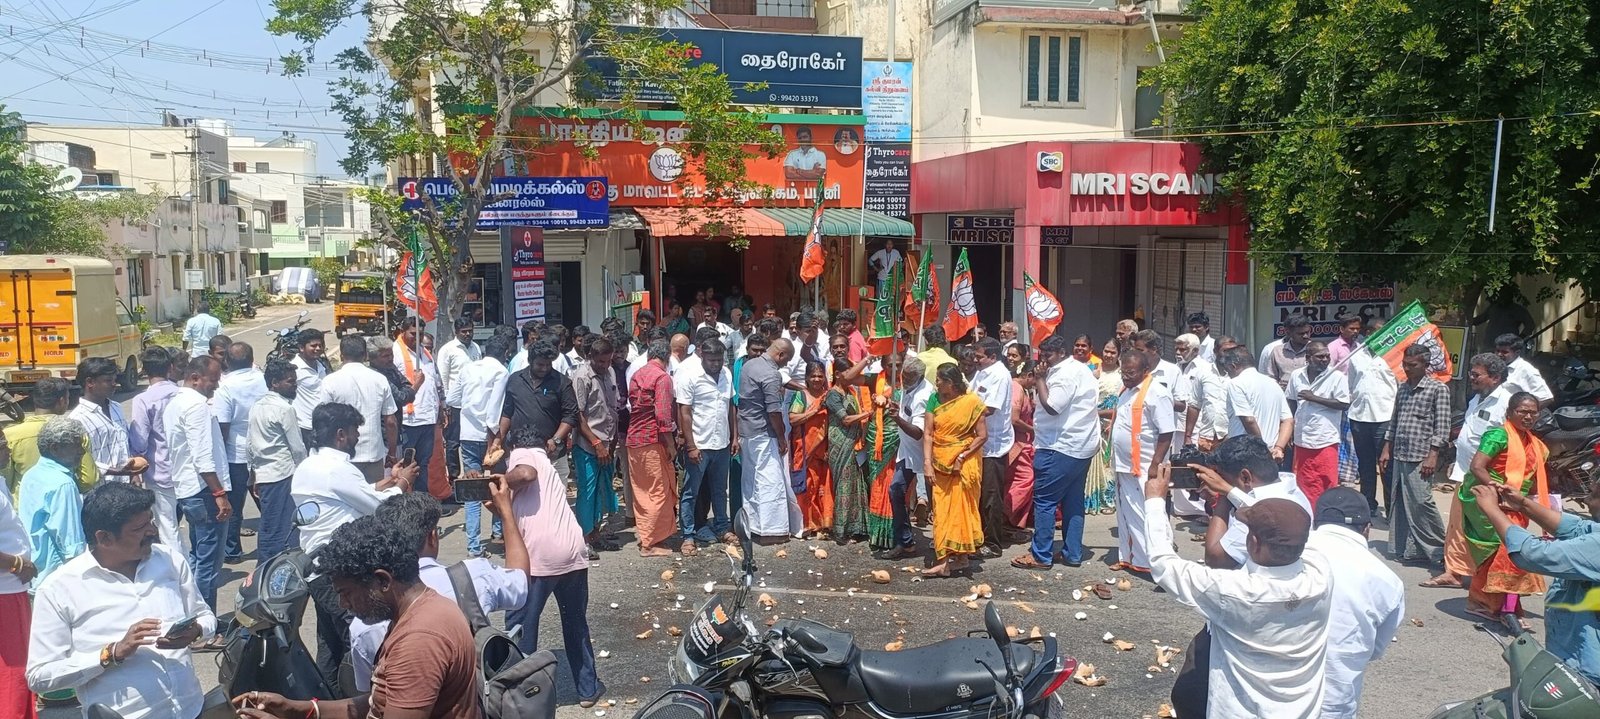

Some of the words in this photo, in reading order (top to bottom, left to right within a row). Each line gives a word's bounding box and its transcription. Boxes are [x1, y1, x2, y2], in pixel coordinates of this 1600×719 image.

[741, 51, 846, 72] தைரோகேர்
[873, 147, 910, 157] Thyrocare
[1043, 157, 1058, 166] SBC
[805, 183, 841, 200] பனி
[1072, 172, 1126, 195] MRI
[951, 229, 985, 243] MRI
[1379, 312, 1426, 347] BJP
